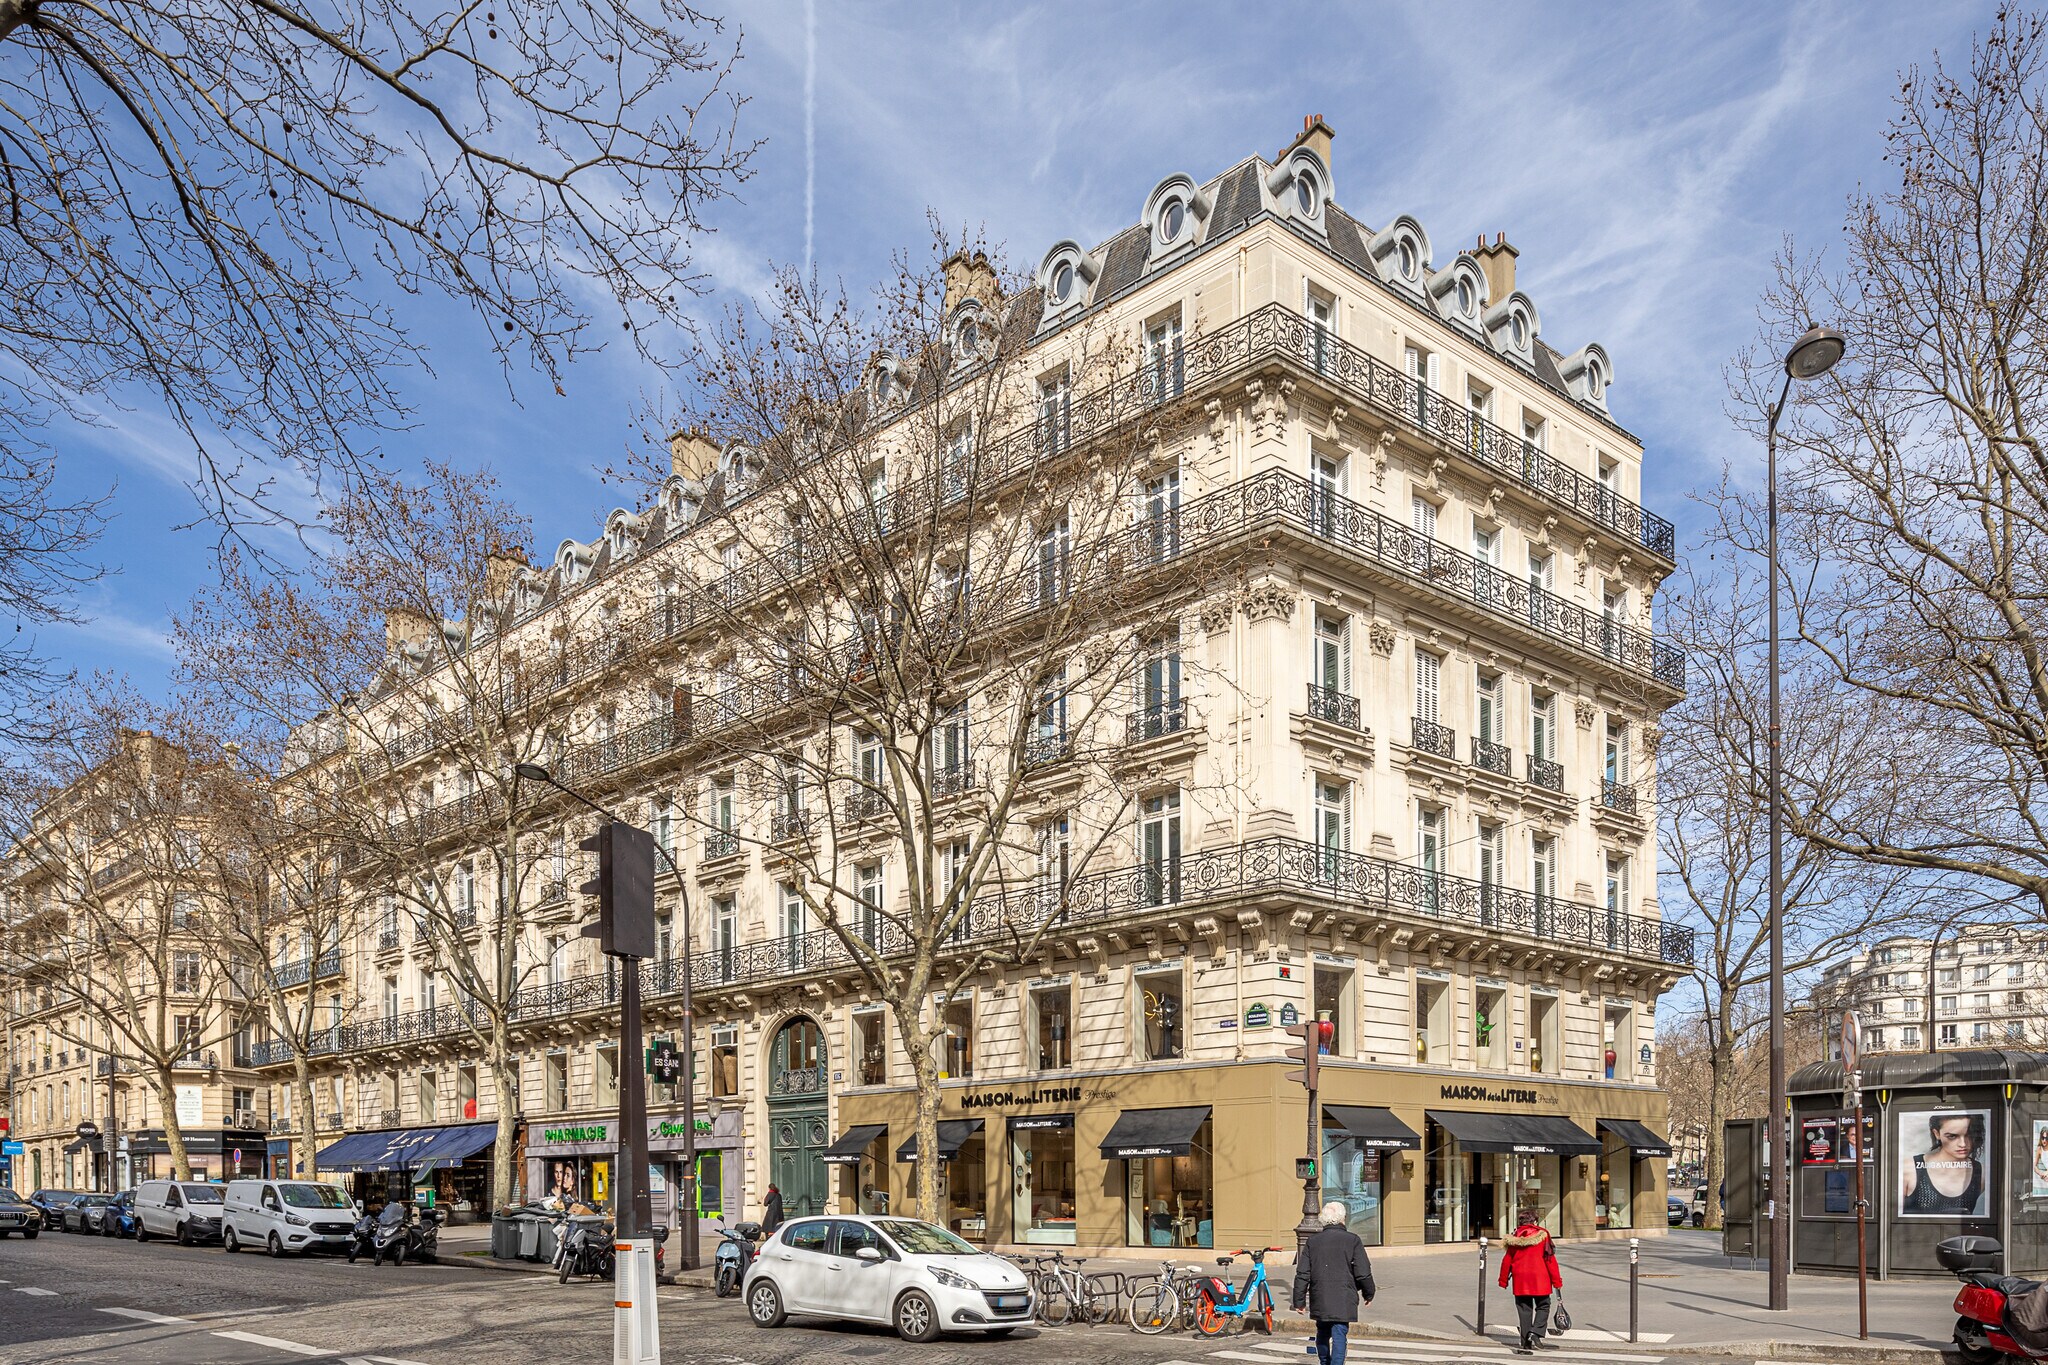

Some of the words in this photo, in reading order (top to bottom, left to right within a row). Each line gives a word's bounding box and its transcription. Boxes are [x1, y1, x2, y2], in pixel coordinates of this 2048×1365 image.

[961, 1092, 1013, 1109] MAISON
[1032, 1087, 1081, 1104] LITERIE
[1440, 1084, 1487, 1102] MAISON
[1501, 1088, 1537, 1104] LITERIE
[545, 1126, 607, 1142] PHARMACIE
